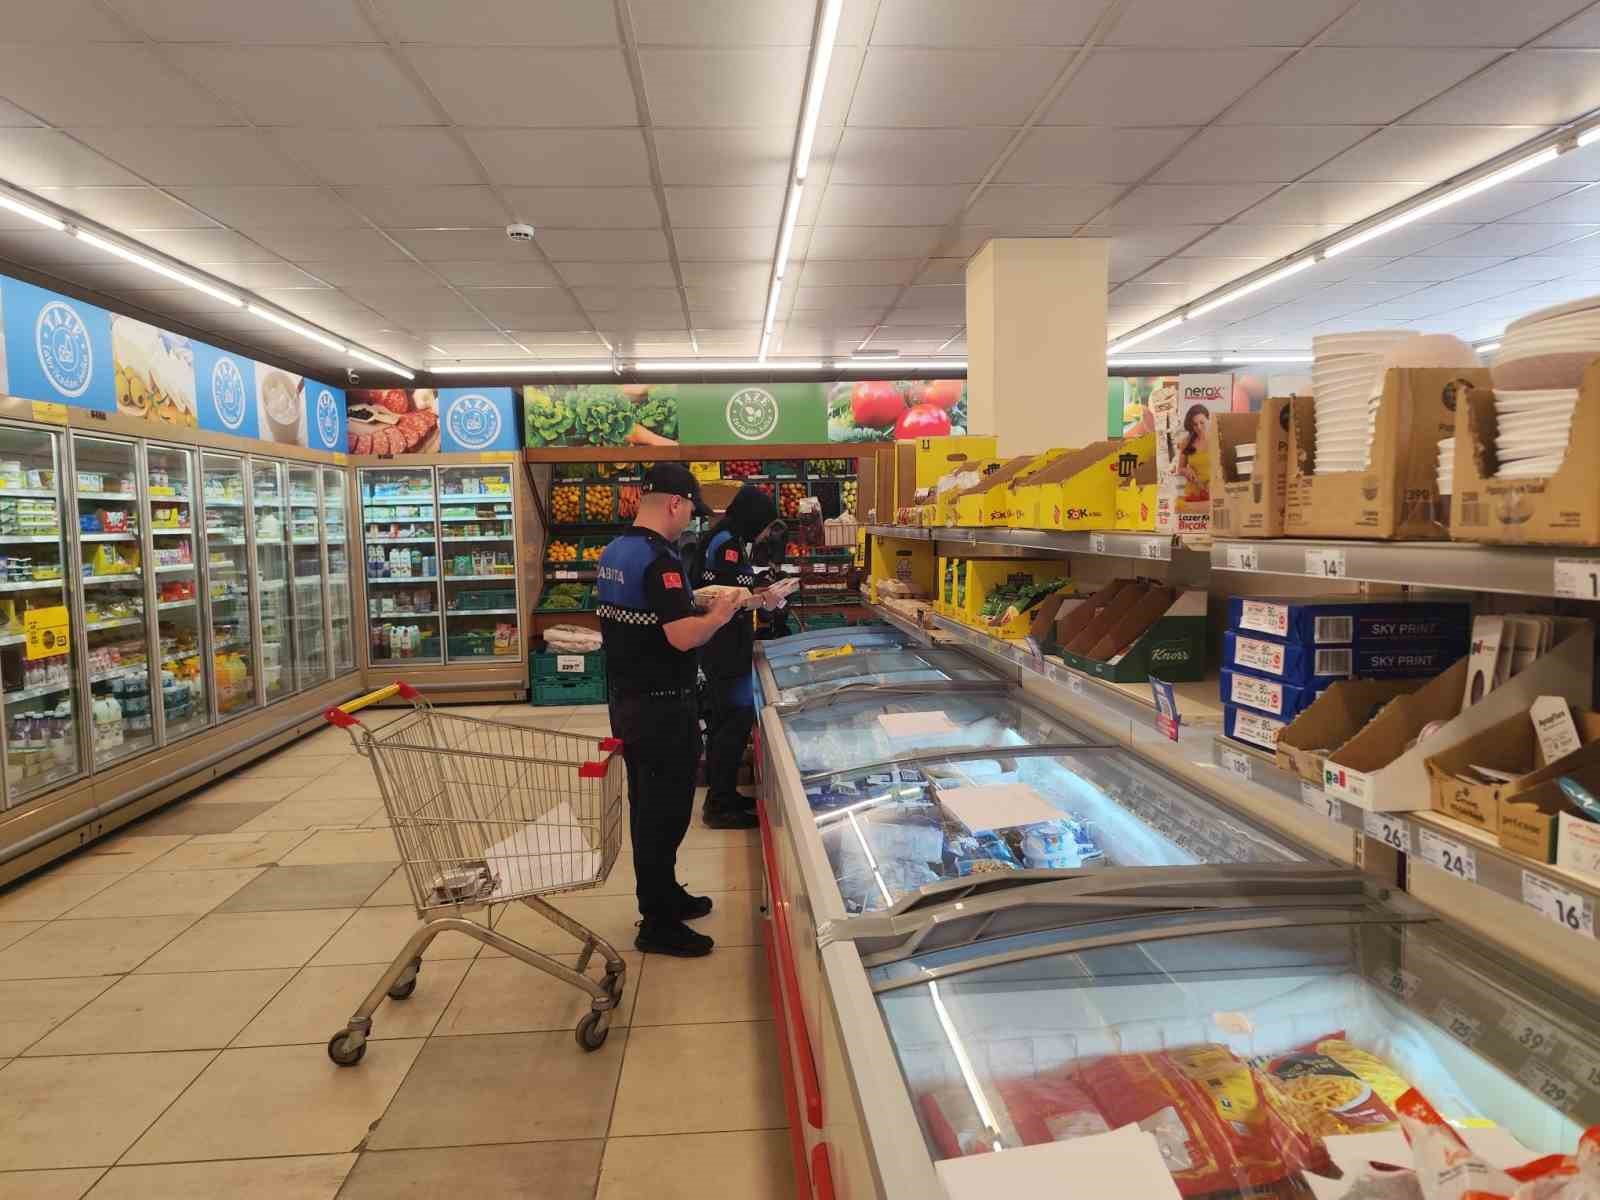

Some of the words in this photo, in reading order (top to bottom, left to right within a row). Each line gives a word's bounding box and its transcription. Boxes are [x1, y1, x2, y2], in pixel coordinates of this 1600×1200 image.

[1240, 554, 1251, 569] 14
[1323, 560, 1337, 576] 14
[1371, 623, 1396, 635] SKY
[1400, 623, 1438, 634] PRINT
[1151, 648, 1189, 661] Knorr
[1371, 656, 1394, 667] SKY
[1398, 656, 1433, 666] PRINT
[1383, 824, 1401, 848] 26
[1442, 850, 1464, 877] 24
[1556, 899, 1580, 930] 16
[1519, 1027, 1544, 1049] 39
[1541, 1079, 1567, 1101] 129
